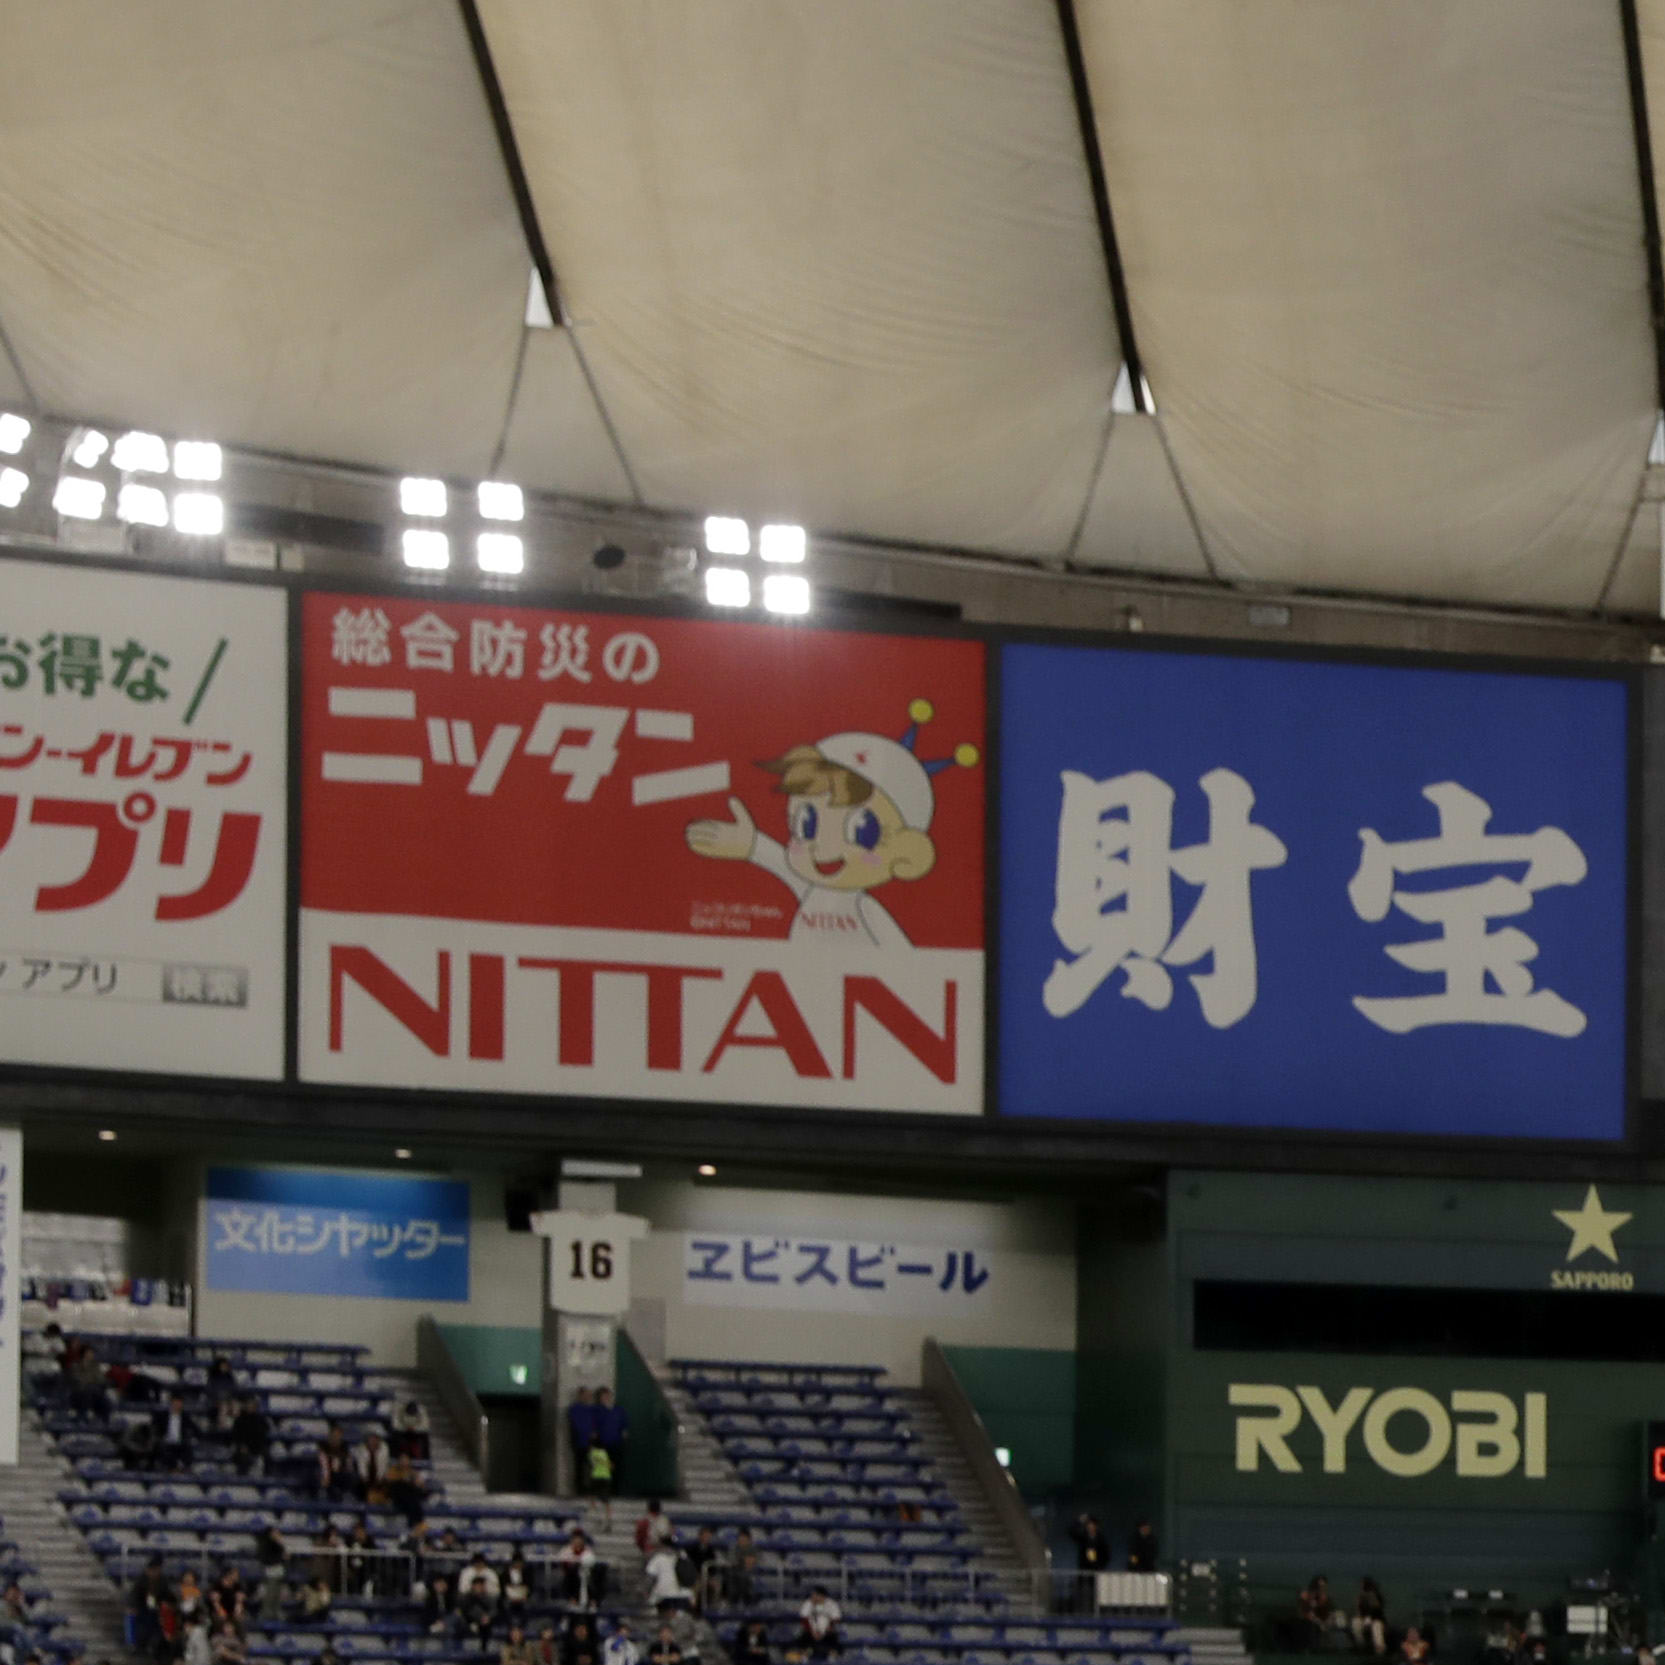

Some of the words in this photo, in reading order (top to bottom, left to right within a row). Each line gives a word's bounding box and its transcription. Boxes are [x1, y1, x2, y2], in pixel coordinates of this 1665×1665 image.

[332, 607, 660, 684] 総合防災の
[322, 687, 730, 806] ニッタン
[1042, 767, 1588, 1038] 財宝
[330, 944, 957, 1085] NITTAN
[571, 1240, 613, 1279] 16
[1550, 1269, 1634, 1292] SAPPORO
[1228, 1383, 1547, 1479] RYOBI
